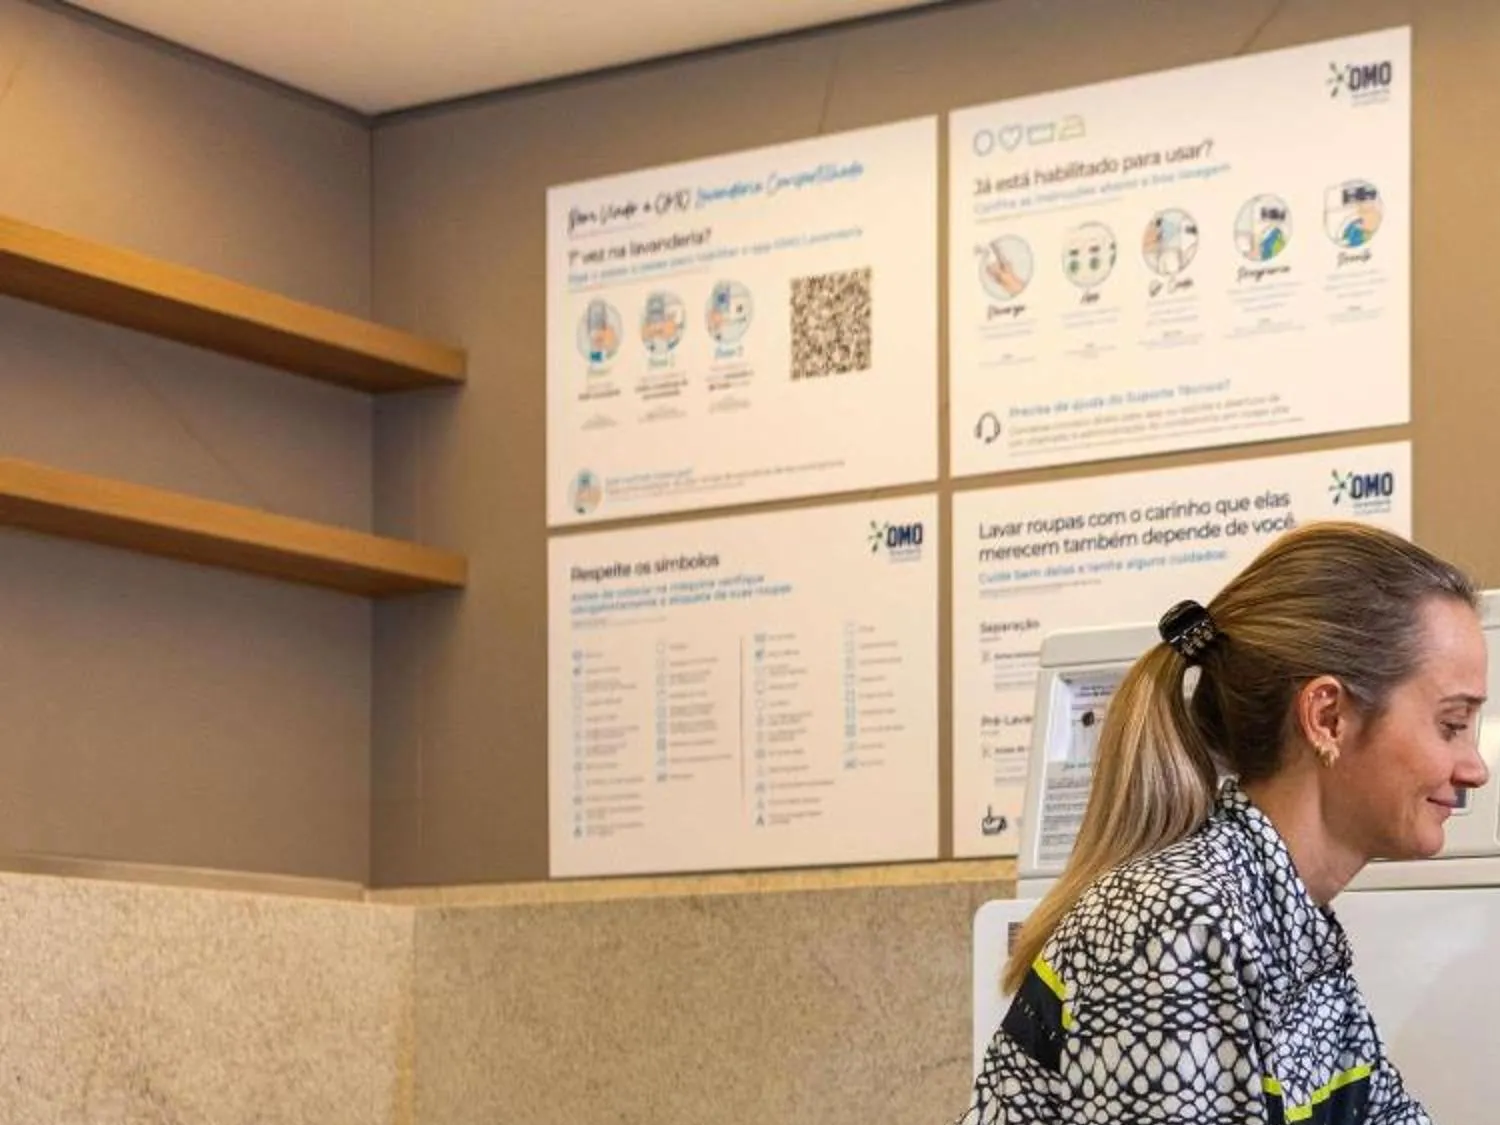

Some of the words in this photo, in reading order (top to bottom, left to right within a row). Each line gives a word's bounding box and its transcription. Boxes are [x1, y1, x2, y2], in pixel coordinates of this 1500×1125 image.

[1348, 60, 1392, 92] OMO
[974, 176, 991, 195] Já
[996, 172, 1029, 192] está
[1034, 156, 1118, 185] habilitado
[1122, 150, 1161, 174] para
[1165, 139, 1214, 164] usar?
[1350, 472, 1394, 499] OMO
[979, 520, 1022, 541] Lavar
[1026, 515, 1084, 538] roupas
[1088, 510, 1126, 528] com
[1130, 509, 1141, 523] o
[1145, 498, 1212, 522] carinho
[1214, 499, 1251, 519] que
[1253, 490, 1291, 510] elas
[885, 522, 924, 548] OMO
[978, 538, 1059, 563] merecem
[1063, 526, 1138, 550] também
[1141, 520, 1222, 547] depende
[1224, 516, 1249, 537] de
[570, 561, 632, 583] Respeite
[634, 562, 651, 576] os
[653, 553, 720, 573] símbolos
